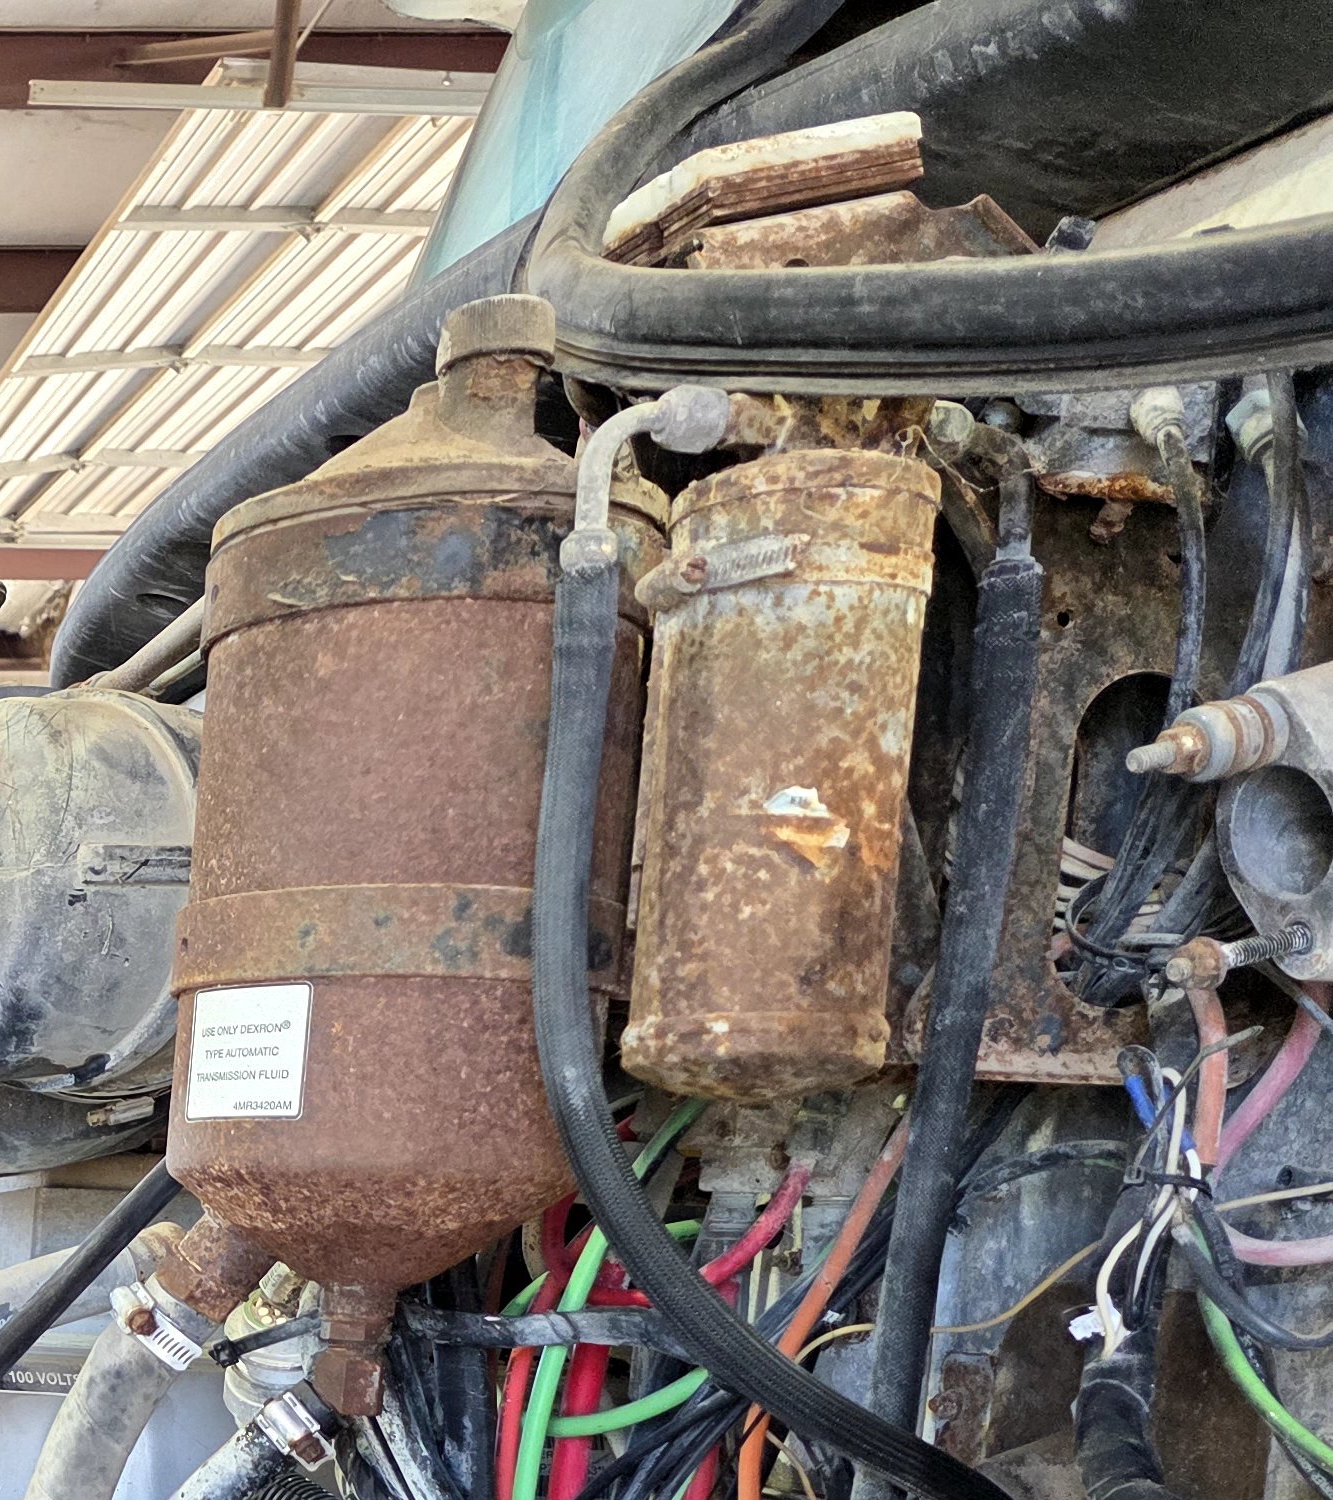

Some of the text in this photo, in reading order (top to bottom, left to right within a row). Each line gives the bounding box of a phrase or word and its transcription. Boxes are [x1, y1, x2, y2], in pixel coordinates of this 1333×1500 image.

[201, 1026, 216, 1038] USE
[217, 1024, 239, 1036] ONLY
[205, 1045, 280, 1060] TYPE AUTOMATIC
[196, 1069, 290, 1083] TRANSMISSION FLUID
[233, 1100, 293, 1111] 4MR3420AM
[8, 1370, 34, 1384] 100
